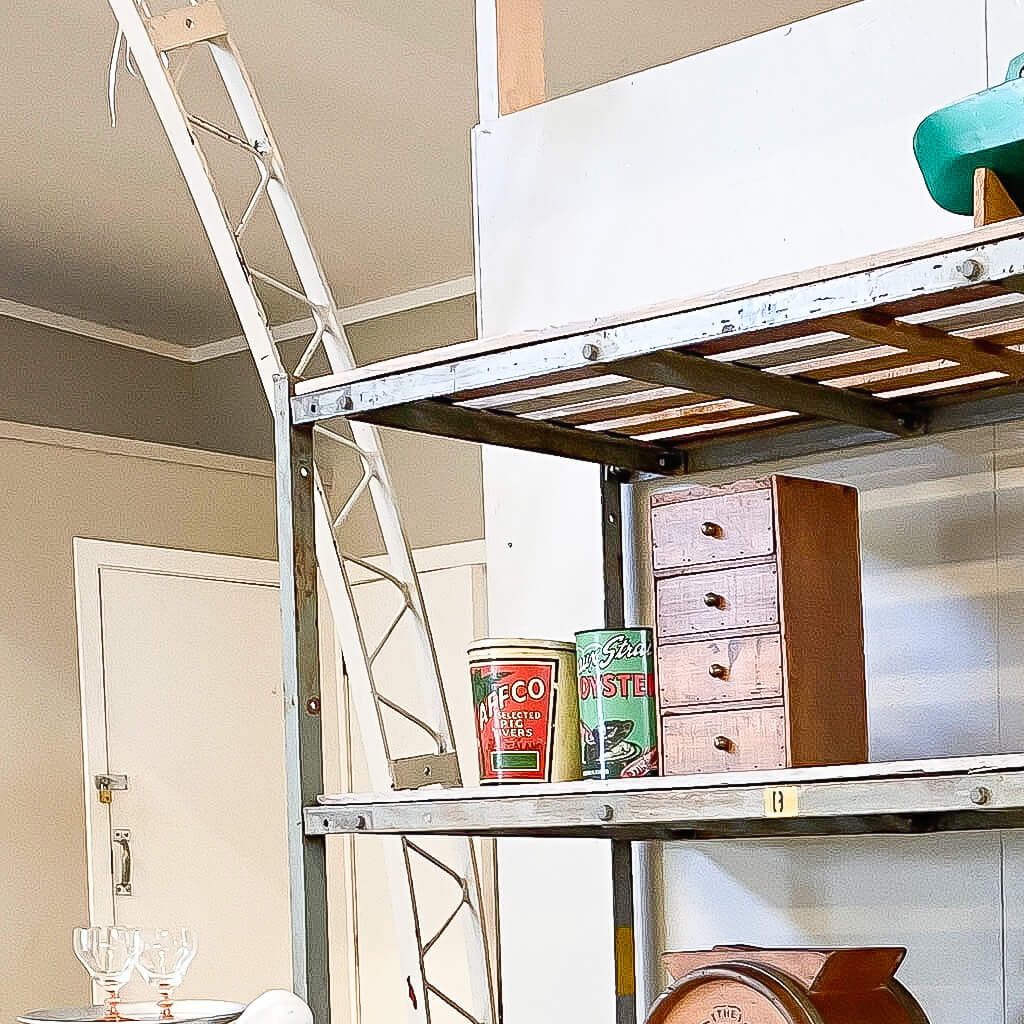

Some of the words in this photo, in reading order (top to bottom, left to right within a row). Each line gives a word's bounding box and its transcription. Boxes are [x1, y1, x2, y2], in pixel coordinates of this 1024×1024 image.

[498, 711, 541, 720] SELECTED
[500, 720, 523, 729] PIG
[494, 728, 533, 737] VERS
[716, 1009, 737, 1020] THE
